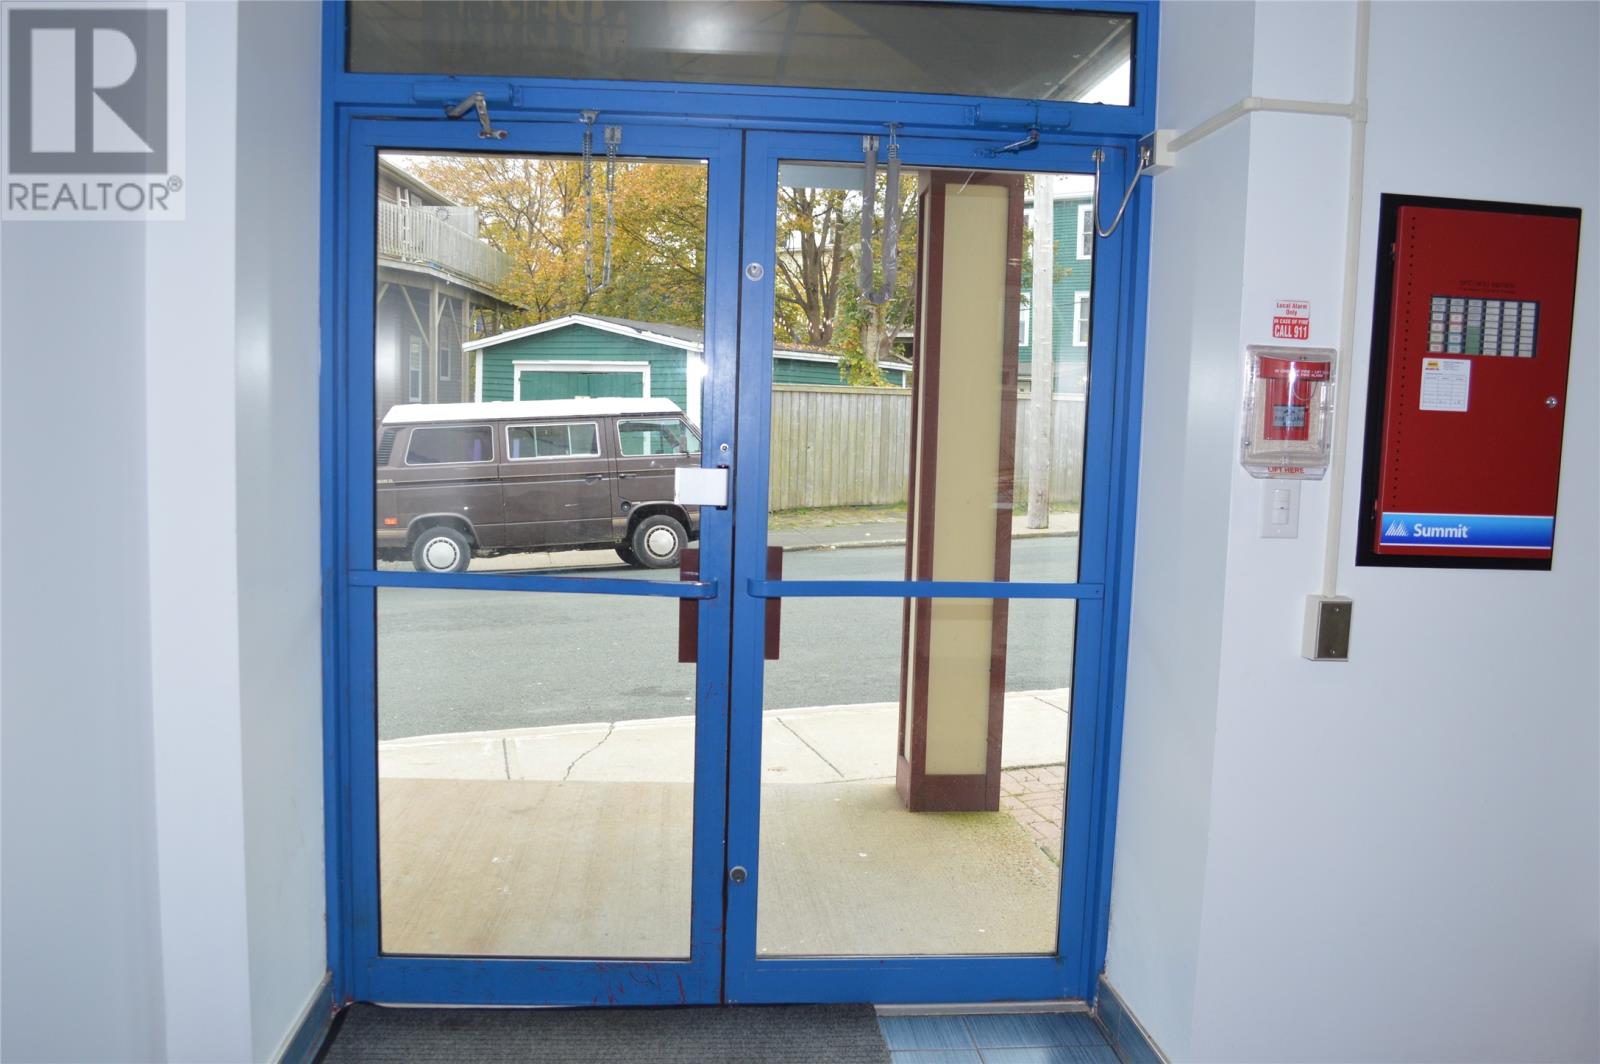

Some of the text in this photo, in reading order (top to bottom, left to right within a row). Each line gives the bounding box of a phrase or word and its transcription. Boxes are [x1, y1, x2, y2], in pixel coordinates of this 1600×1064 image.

[1274, 324, 1308, 339] CALL 911
[1267, 465, 1305, 474] LIFT HERE
[1413, 523, 1469, 539] Summit
